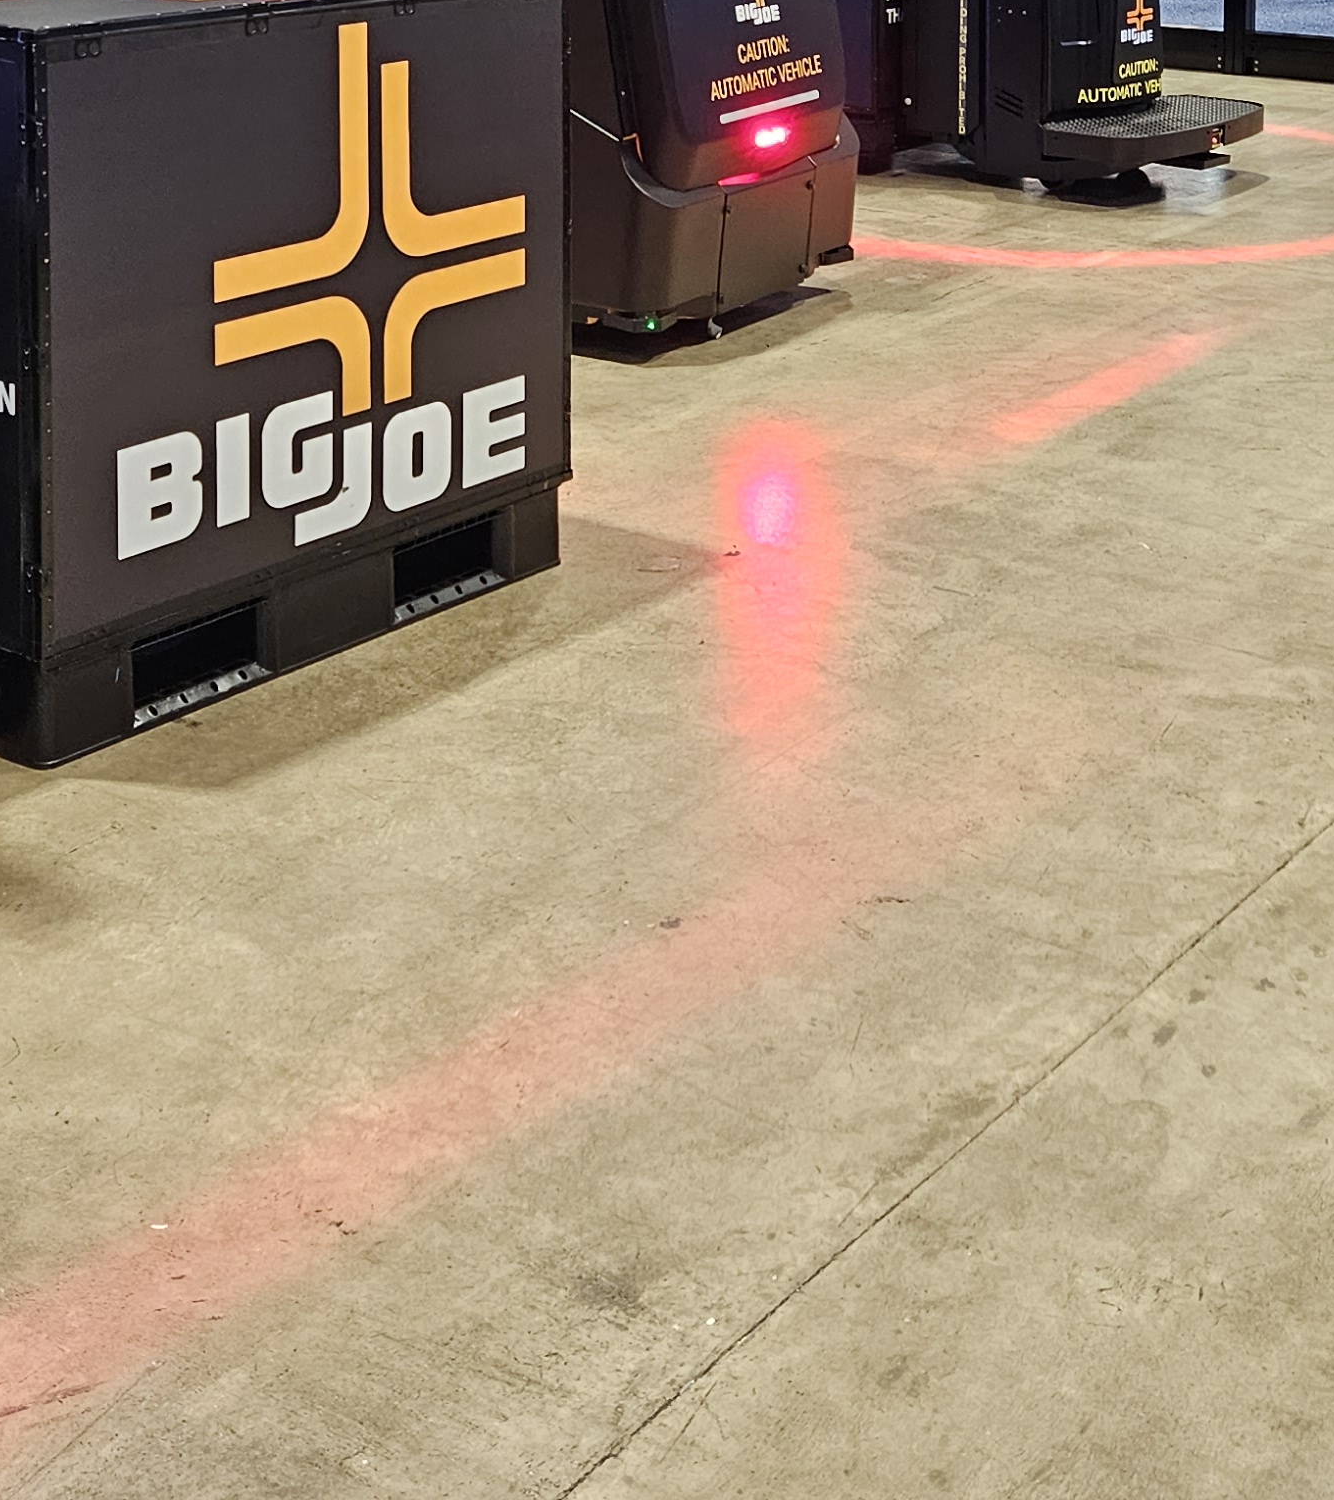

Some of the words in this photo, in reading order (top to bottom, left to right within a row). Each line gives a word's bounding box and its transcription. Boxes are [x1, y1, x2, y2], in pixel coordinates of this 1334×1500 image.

[737, 34, 790, 65] CAUTION:
[711, 64, 777, 102] AUTOMATIC
[778, 55, 823, 83] VEHICLE
[1119, 58, 1159, 79] CAUTION:
[1078, 82, 1143, 104] AUTOMATIC
